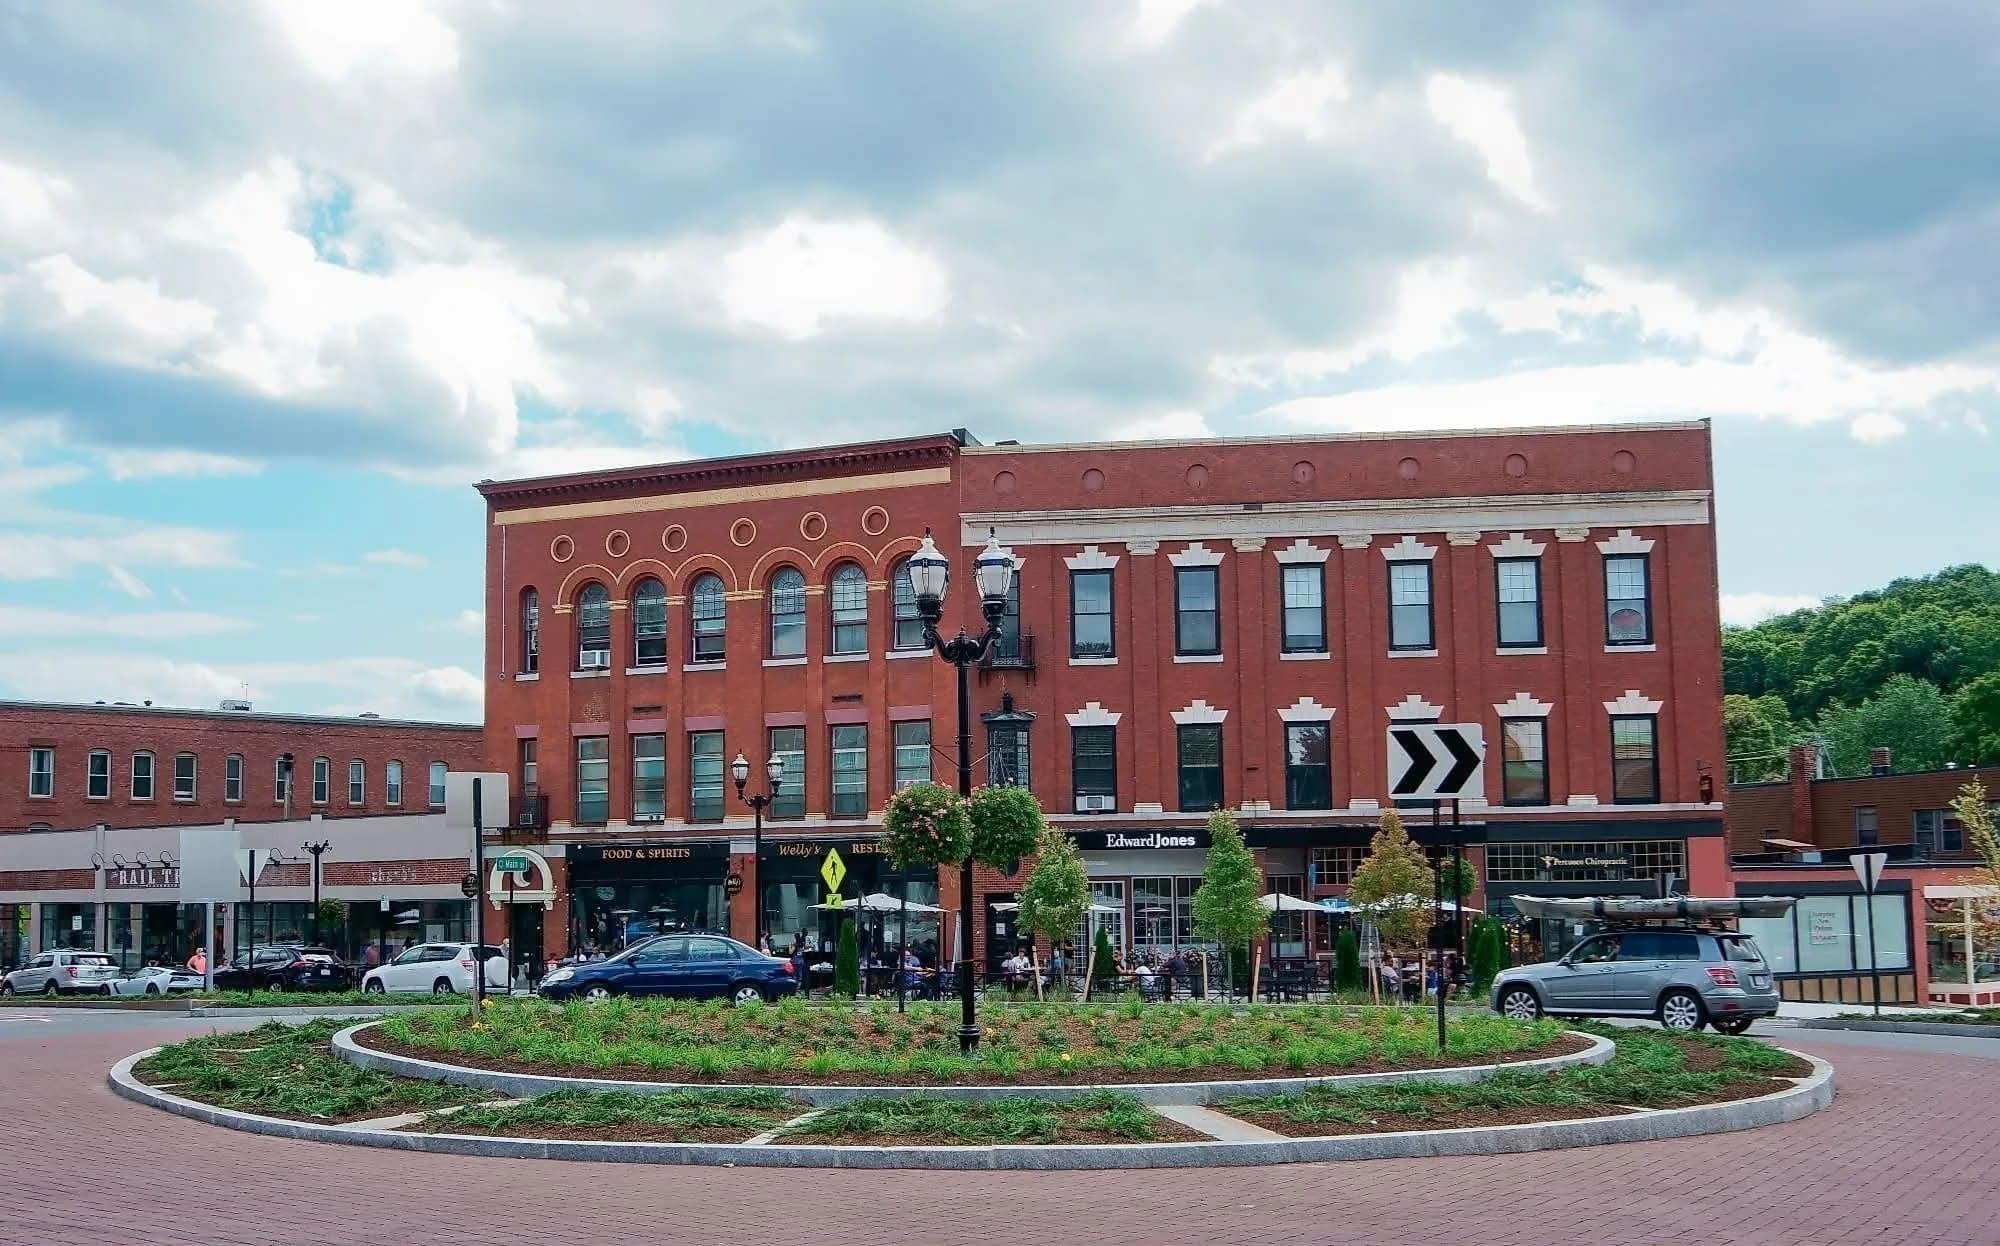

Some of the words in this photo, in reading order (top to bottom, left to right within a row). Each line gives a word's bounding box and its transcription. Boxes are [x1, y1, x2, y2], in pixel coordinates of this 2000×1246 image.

[602, 849, 632, 859] FOOD
[635, 849, 646, 858] &
[648, 848, 690, 858] SPIRITS
[779, 842, 822, 857] Welly's
[1585, 857, 1628, 868] Chiropractic
[120, 868, 156, 885] RAIL
